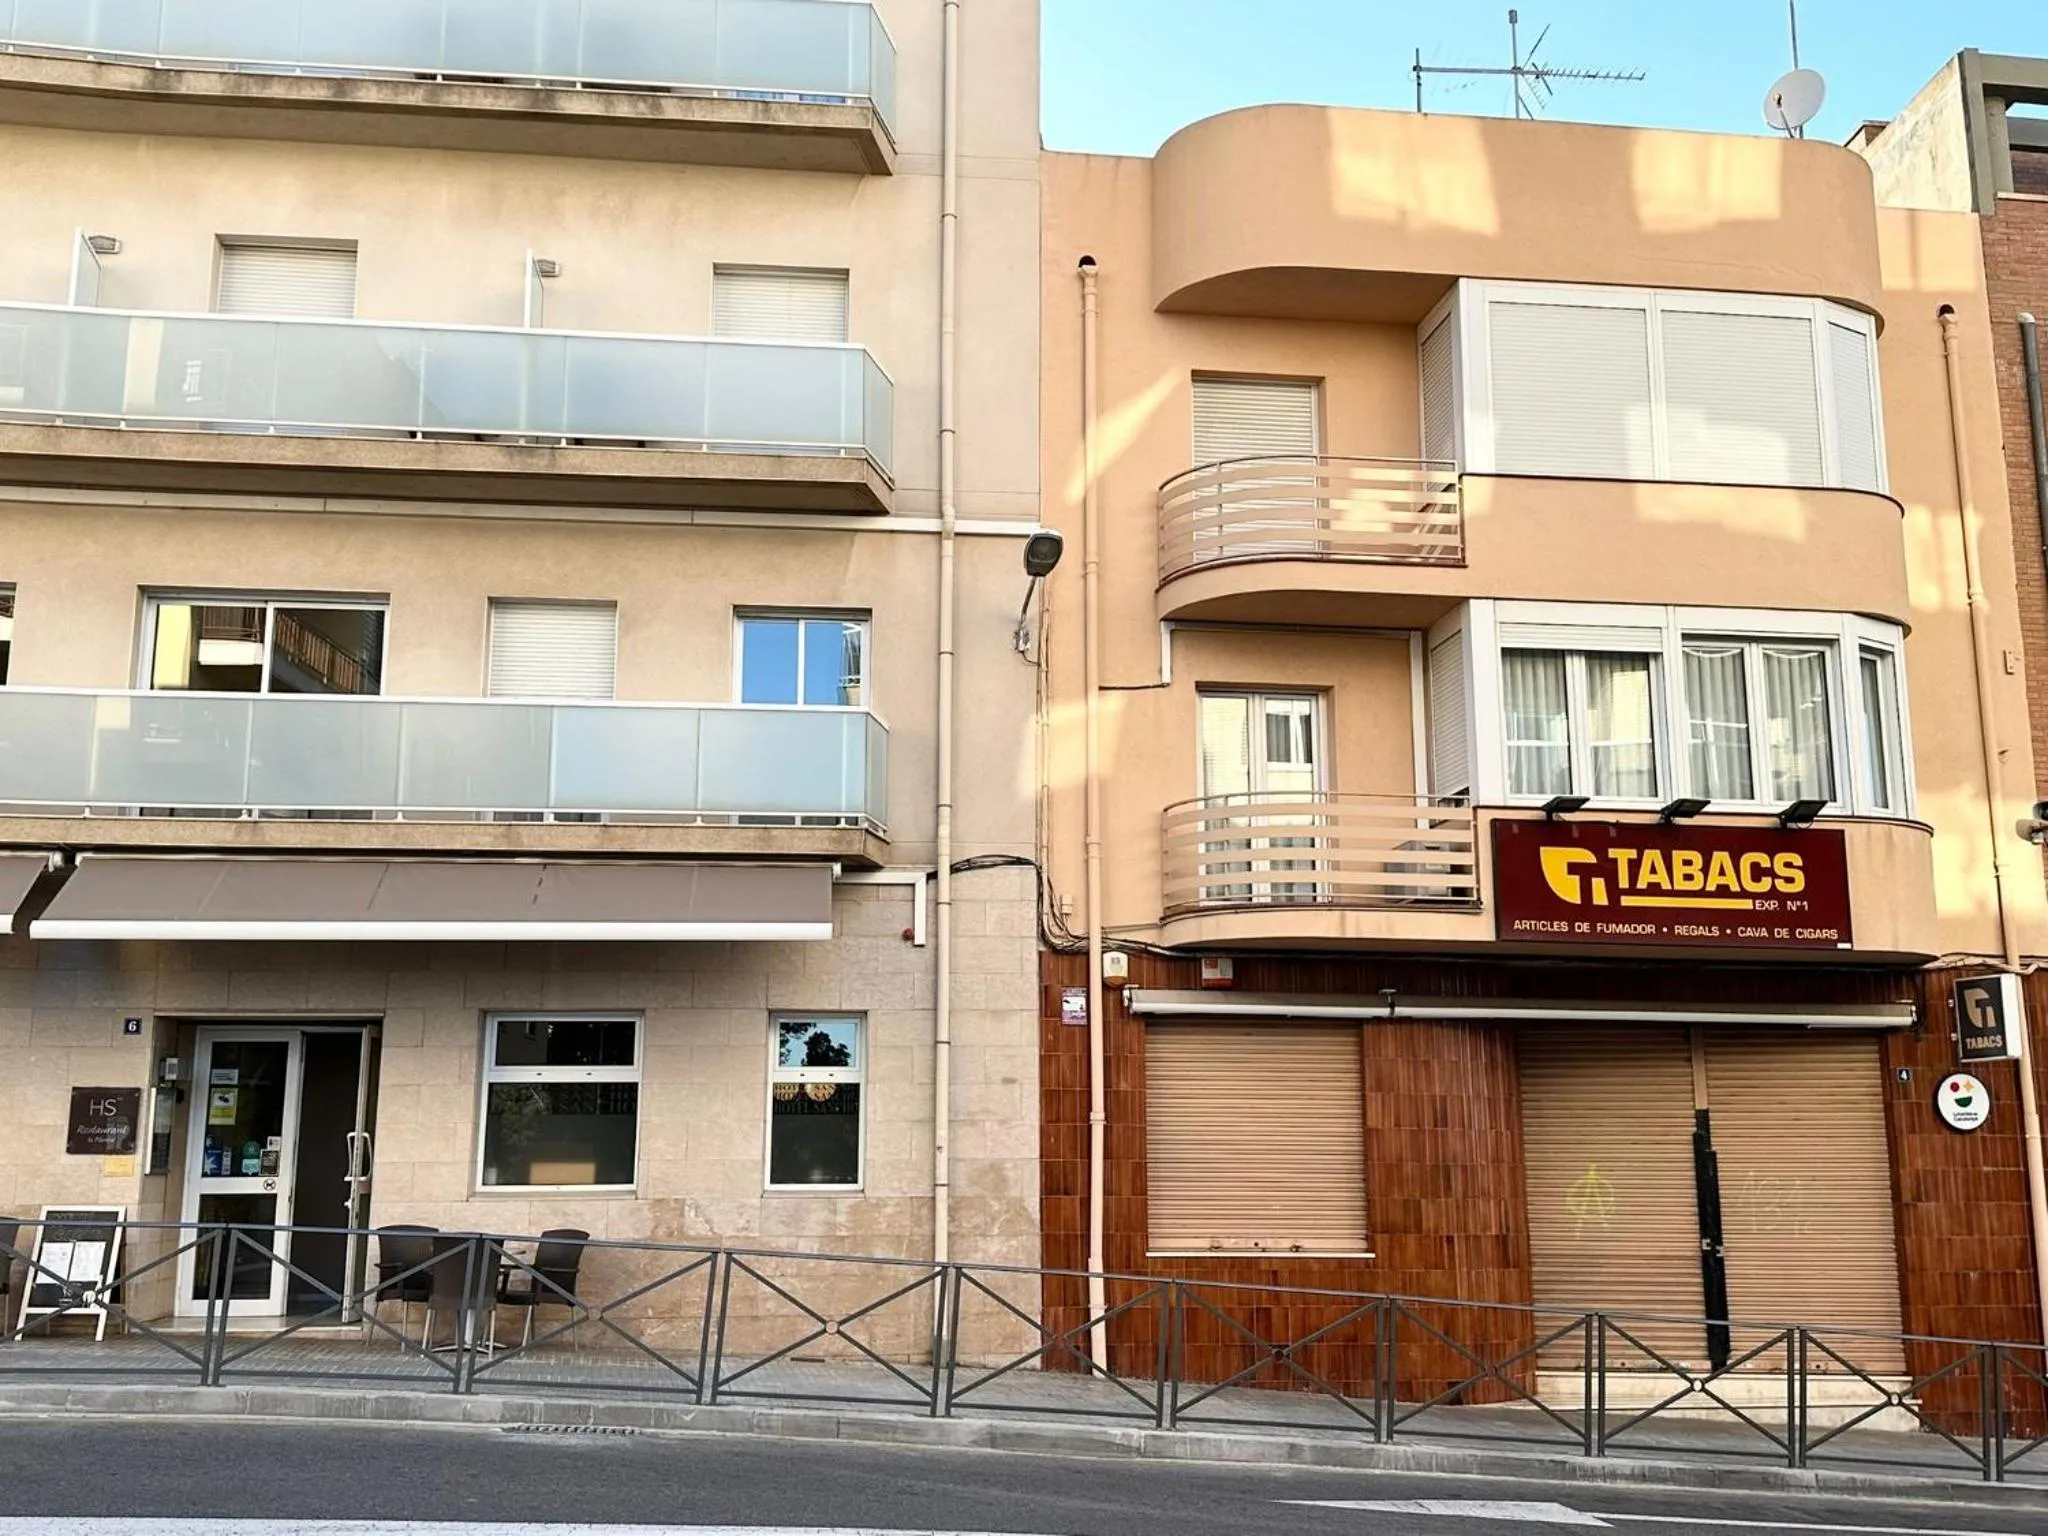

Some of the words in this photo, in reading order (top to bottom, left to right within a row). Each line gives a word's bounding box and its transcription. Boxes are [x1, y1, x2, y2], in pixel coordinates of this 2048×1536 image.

[1608, 847, 1806, 893] TABACS
[1755, 899, 1780, 911] EXP.
[1513, 919, 1569, 933] ARTICLES
[1574, 921, 1591, 933] DE
[1596, 922, 1656, 935] FUMADOR
[1674, 924, 1720, 937] REGALS
[1737, 926, 1769, 938] CAVA
[1774, 927, 1790, 939] DE
[1795, 927, 1839, 940] CIGARS
[127, 1020, 137, 1032] 6
[1965, 1035, 2003, 1050] TABACS
[89, 1098, 117, 1117] HS
